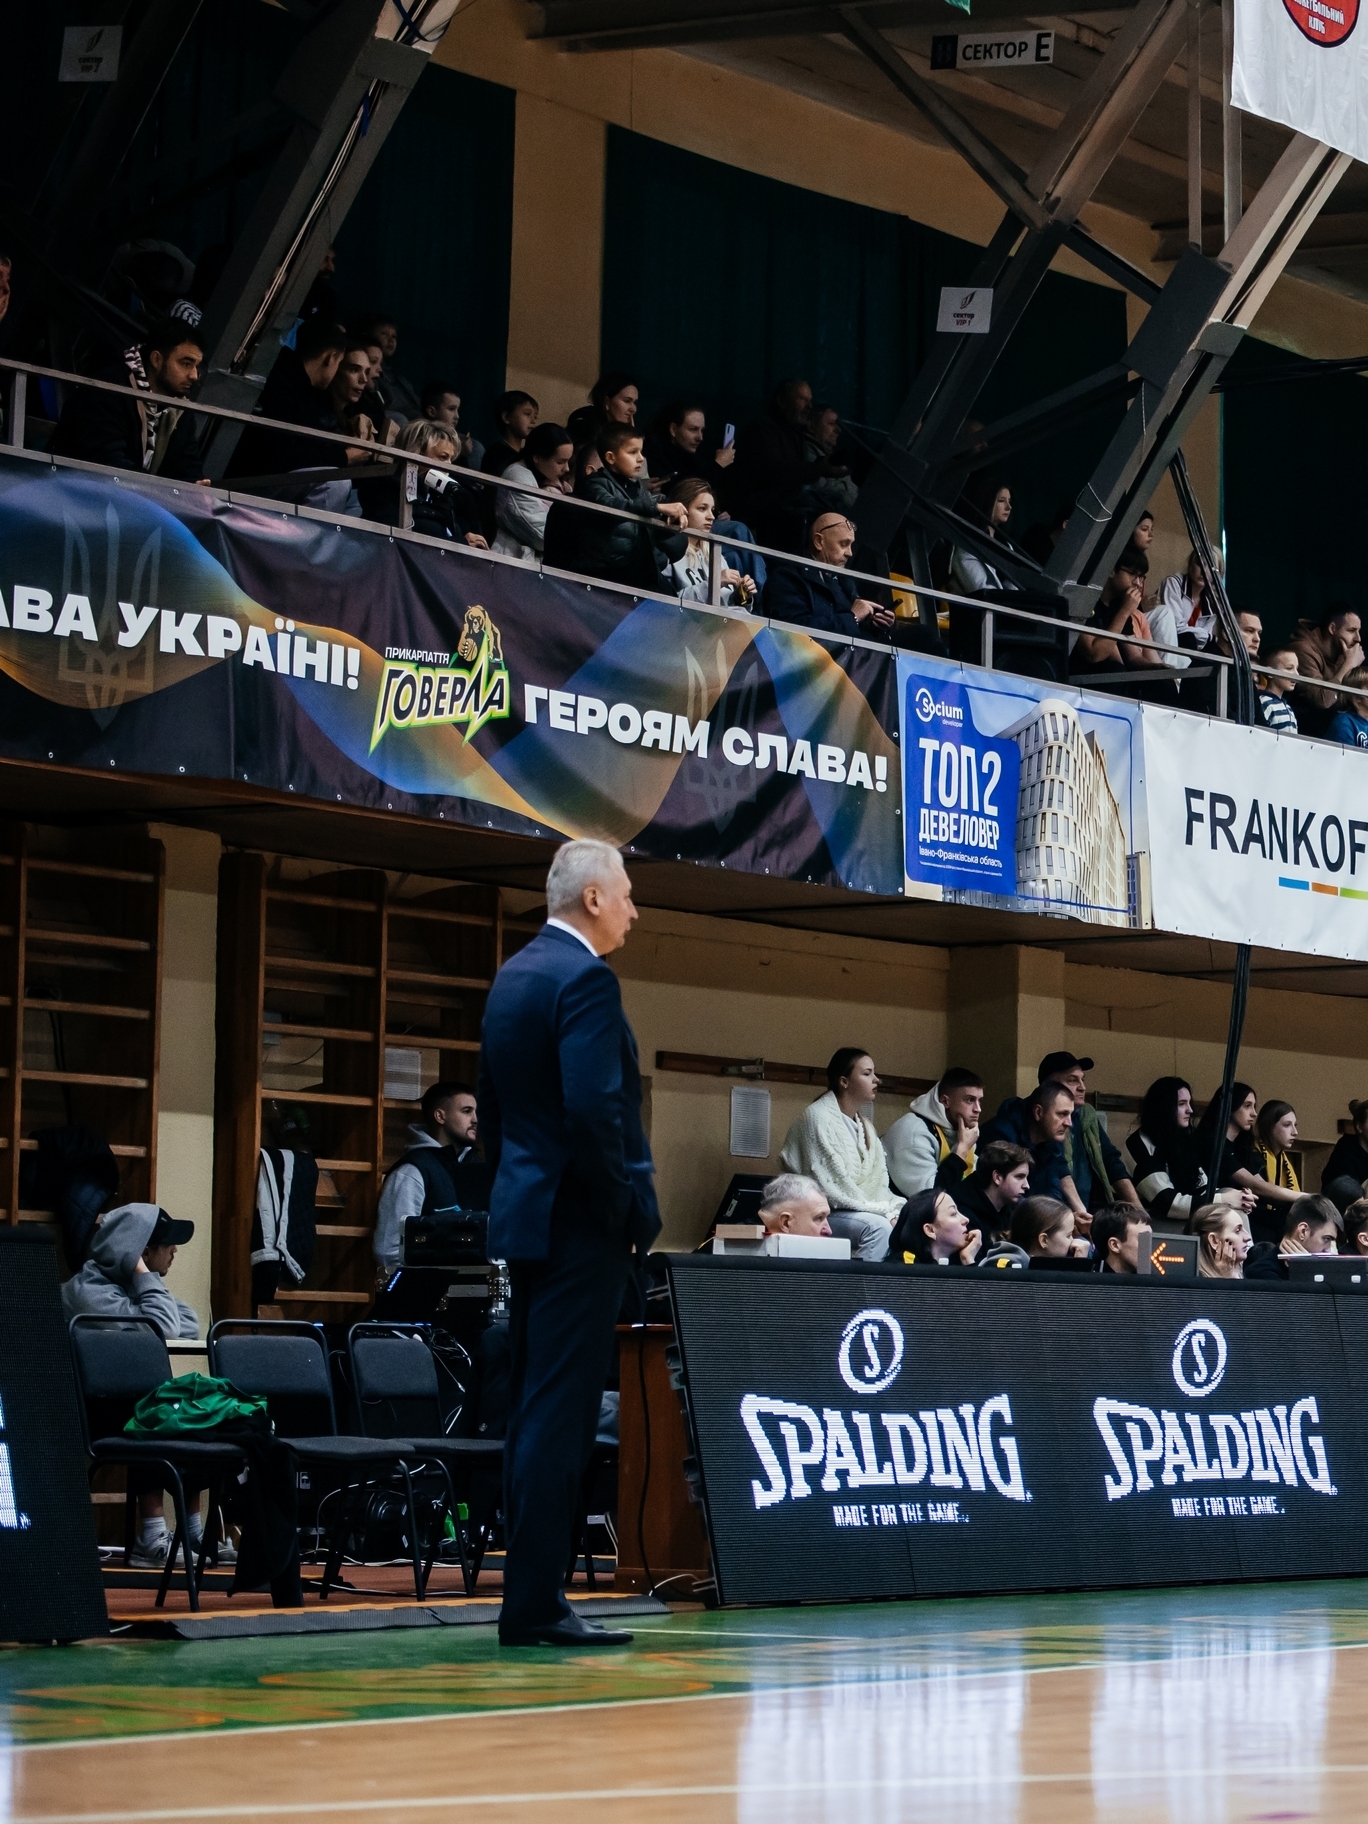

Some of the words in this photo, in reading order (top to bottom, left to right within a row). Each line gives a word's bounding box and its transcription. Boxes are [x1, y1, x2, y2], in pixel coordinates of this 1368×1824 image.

[962, 41, 1028, 61] СЕКТОР
[1035, 32, 1051, 62] E
[0, 585, 98, 641] ВА
[117, 601, 361, 690] УКРАЇНІ!
[385, 647, 449, 664] ПРИКАРПАТТЯ
[376, 660, 507, 734] ГОВЕРЛА
[524, 683, 711, 758] ГЕРОЯМ
[722, 727, 888, 793] СЛАВА!
[919, 808, 999, 850] ДЕВЕЛОВЕР
[919, 845, 979, 864] Івано-Франківська
[980, 855, 1003, 868] область
[1184, 787, 1368, 875] FRANKOF
[740, 1394, 1032, 1509] SPALDING
[1093, 1396, 1336, 1501] SPALDING
[833, 1505, 868, 1526] MADE
[872, 1504, 898, 1526] FOR
[899, 1503, 925, 1523] THE
[1171, 1498, 1202, 1517] MADE
[1203, 1498, 1226, 1515] FOR
[1226, 1497, 1248, 1515] THE
